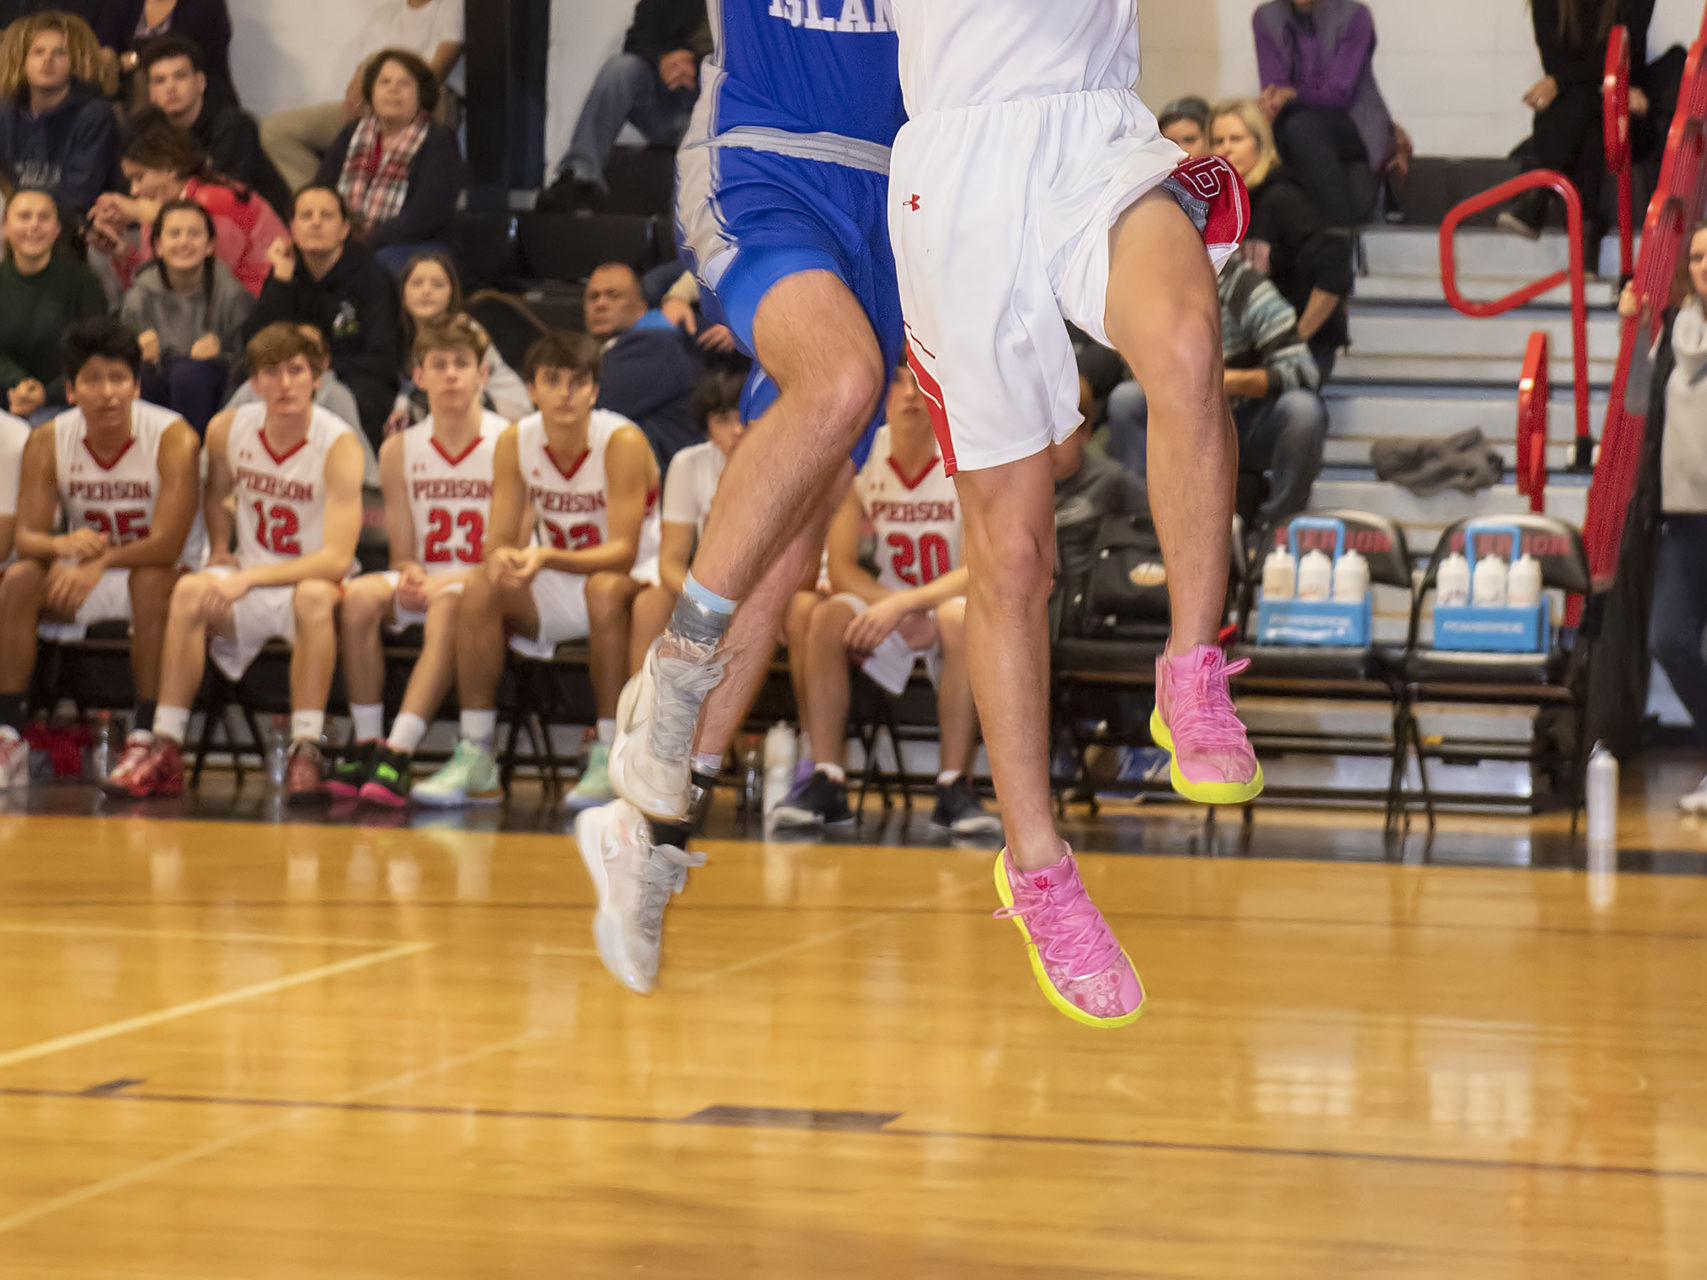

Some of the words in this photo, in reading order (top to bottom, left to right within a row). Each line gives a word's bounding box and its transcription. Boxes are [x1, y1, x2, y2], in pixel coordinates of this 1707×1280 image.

[412, 479, 493, 500] PIERSON
[253, 500, 301, 555] 12
[425, 508, 484, 563] 23
[886, 531, 951, 587] 20
